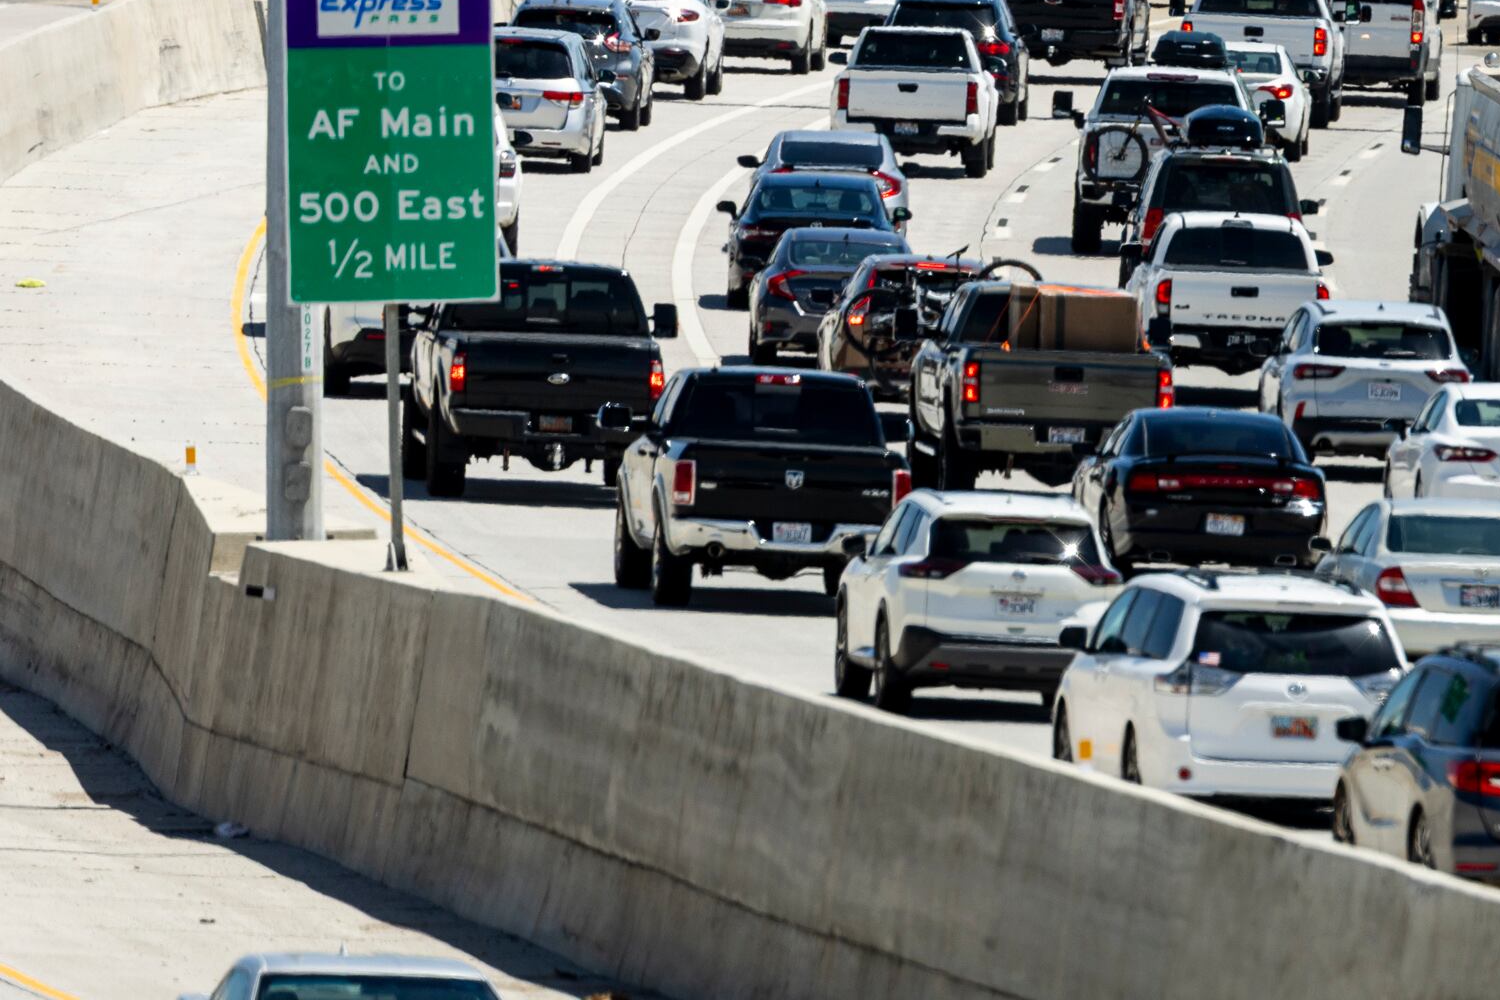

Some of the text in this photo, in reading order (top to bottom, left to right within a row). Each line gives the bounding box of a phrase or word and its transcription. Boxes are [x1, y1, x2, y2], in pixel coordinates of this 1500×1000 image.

[370, 13, 439, 23] PASS
[373, 71, 405, 91] TO
[308, 106, 474, 139] AF Main
[364, 154, 419, 174] AND
[299, 188, 484, 224] 500 East
[385, 242, 457, 271] MILE
